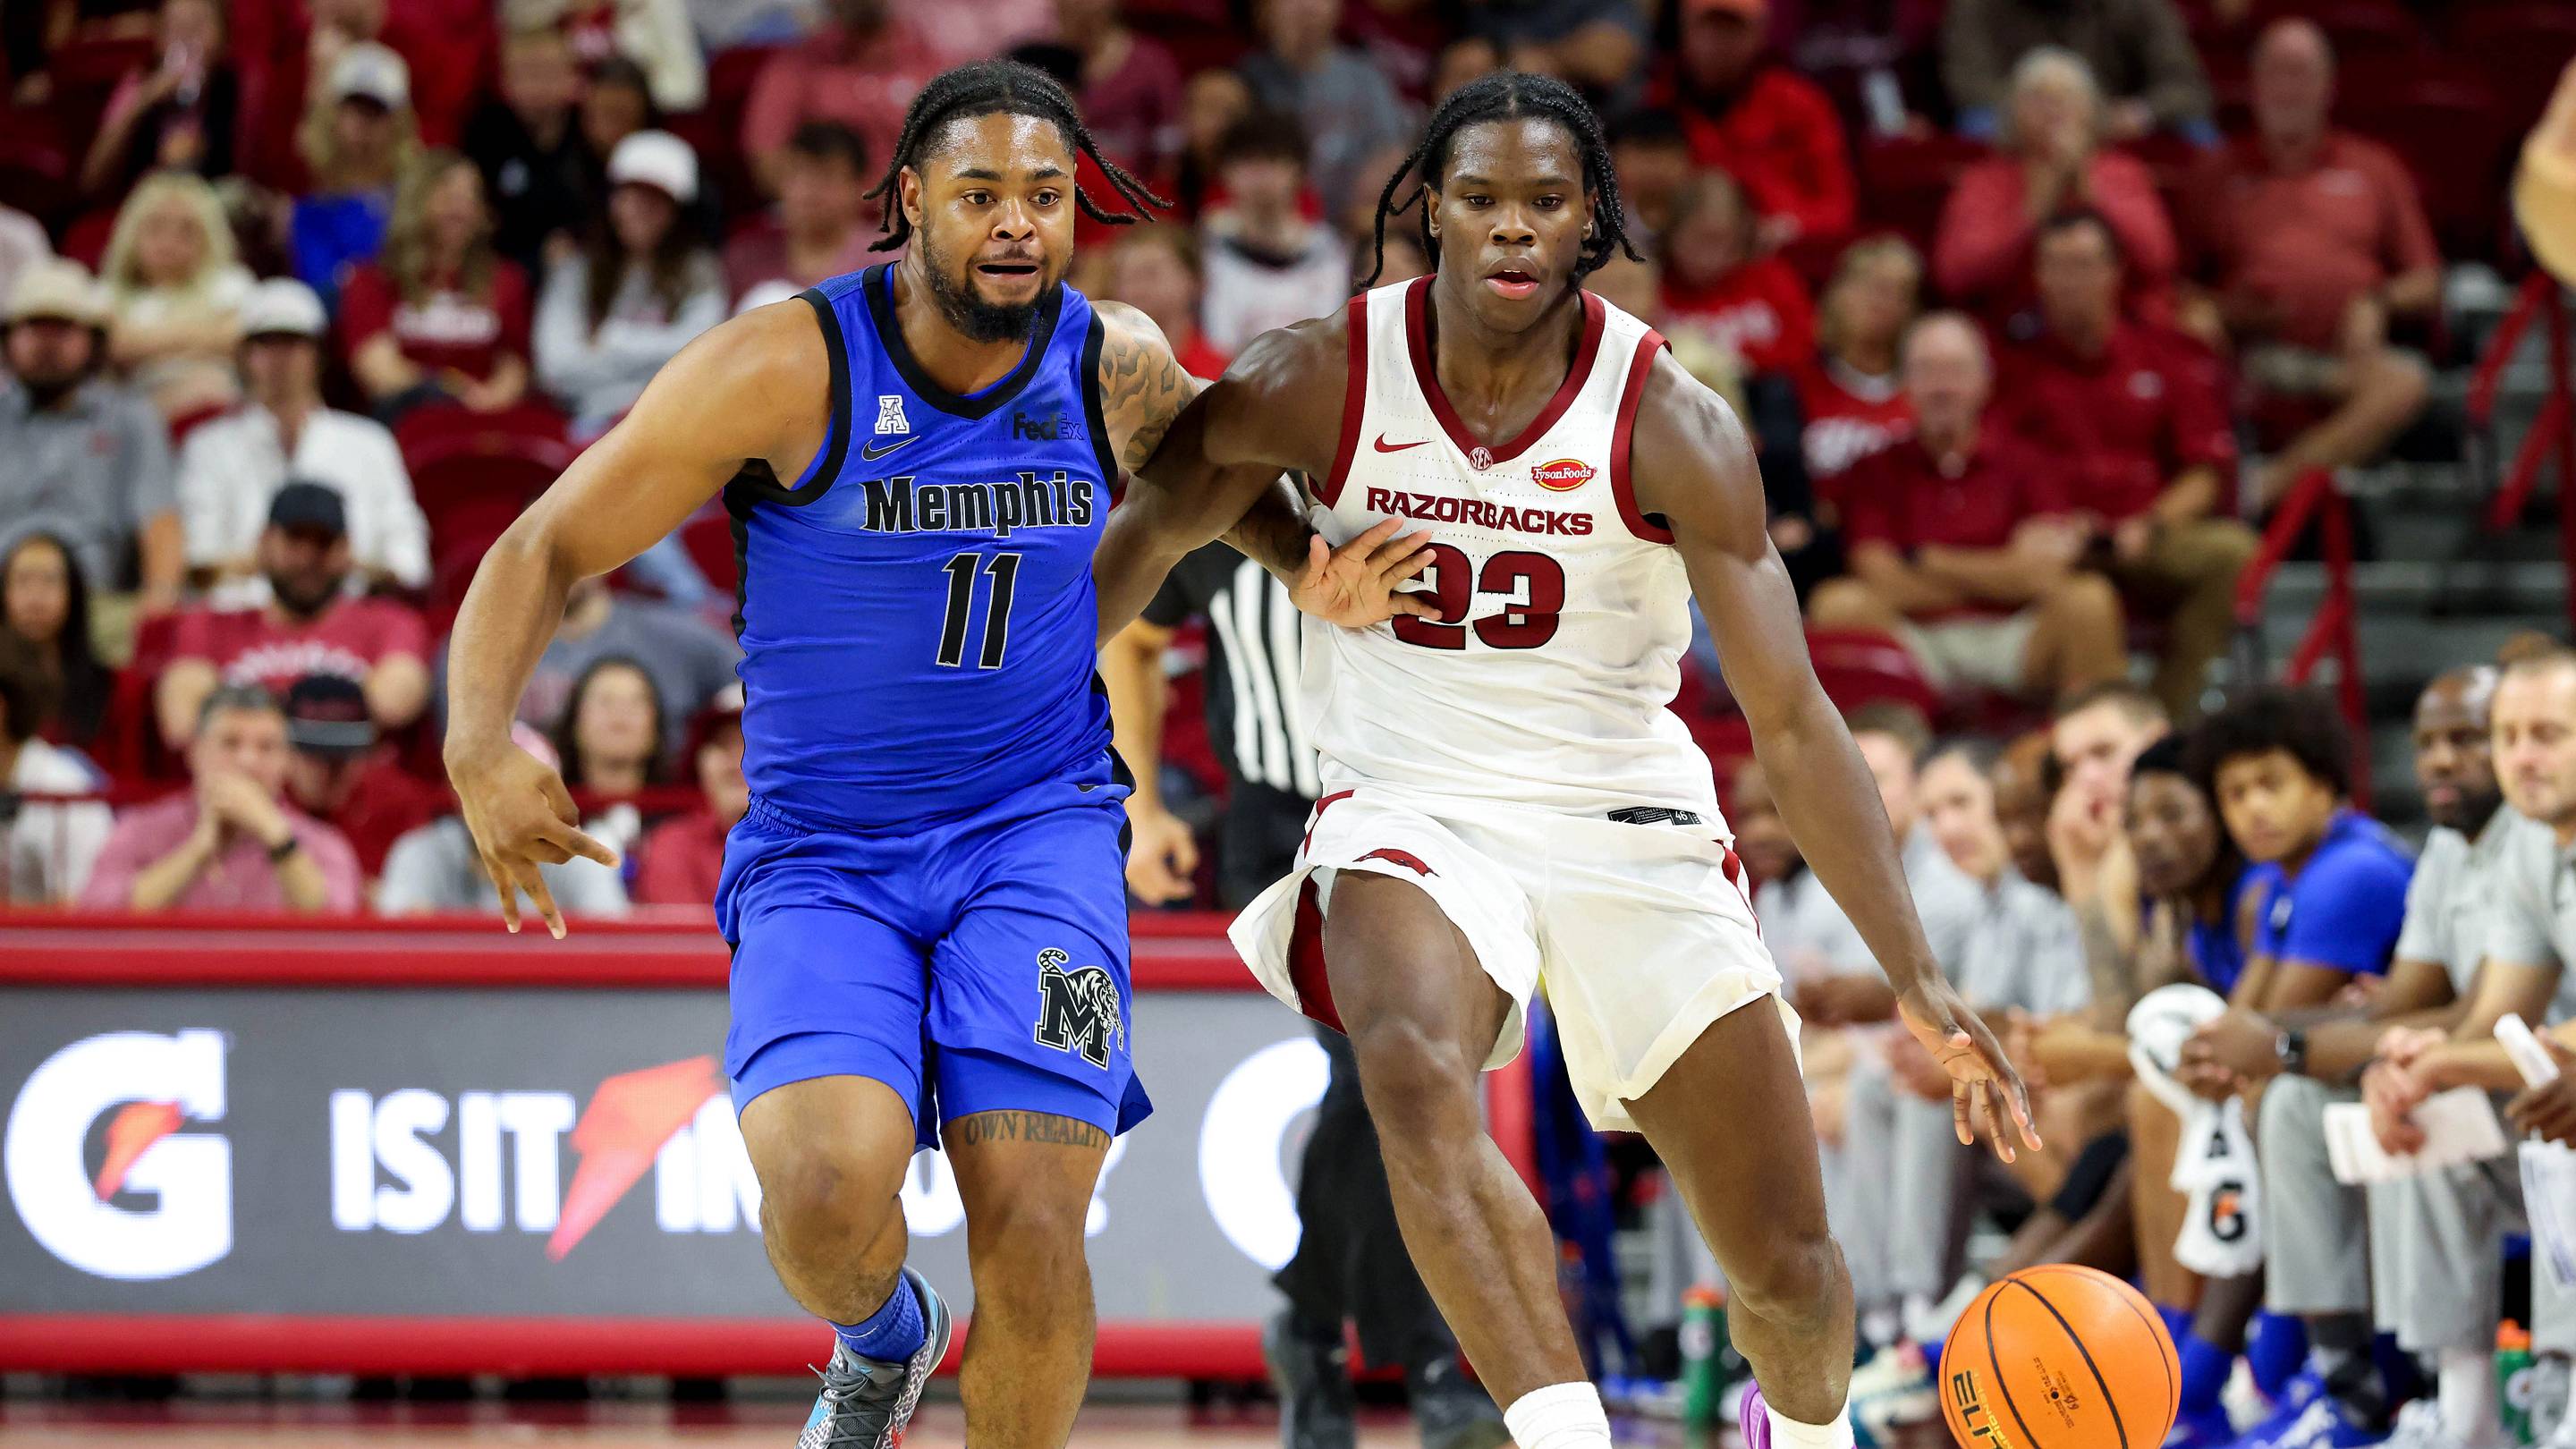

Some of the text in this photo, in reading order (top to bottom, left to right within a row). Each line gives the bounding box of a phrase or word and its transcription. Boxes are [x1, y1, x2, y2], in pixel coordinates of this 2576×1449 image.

[1013, 411, 1085, 441] FedEx
[1470, 448, 1493, 470] SEC
[860, 470, 1093, 538] Memphis
[1367, 486, 1594, 537] RAZORBACKS
[936, 552, 1023, 670] 11
[1389, 541, 1566, 651] 23
[1675, 810, 1689, 821] 46
[1034, 967, 1111, 1072] M
[4, 1027, 234, 1281] G
[964, 1113, 1019, 1146] OWN
